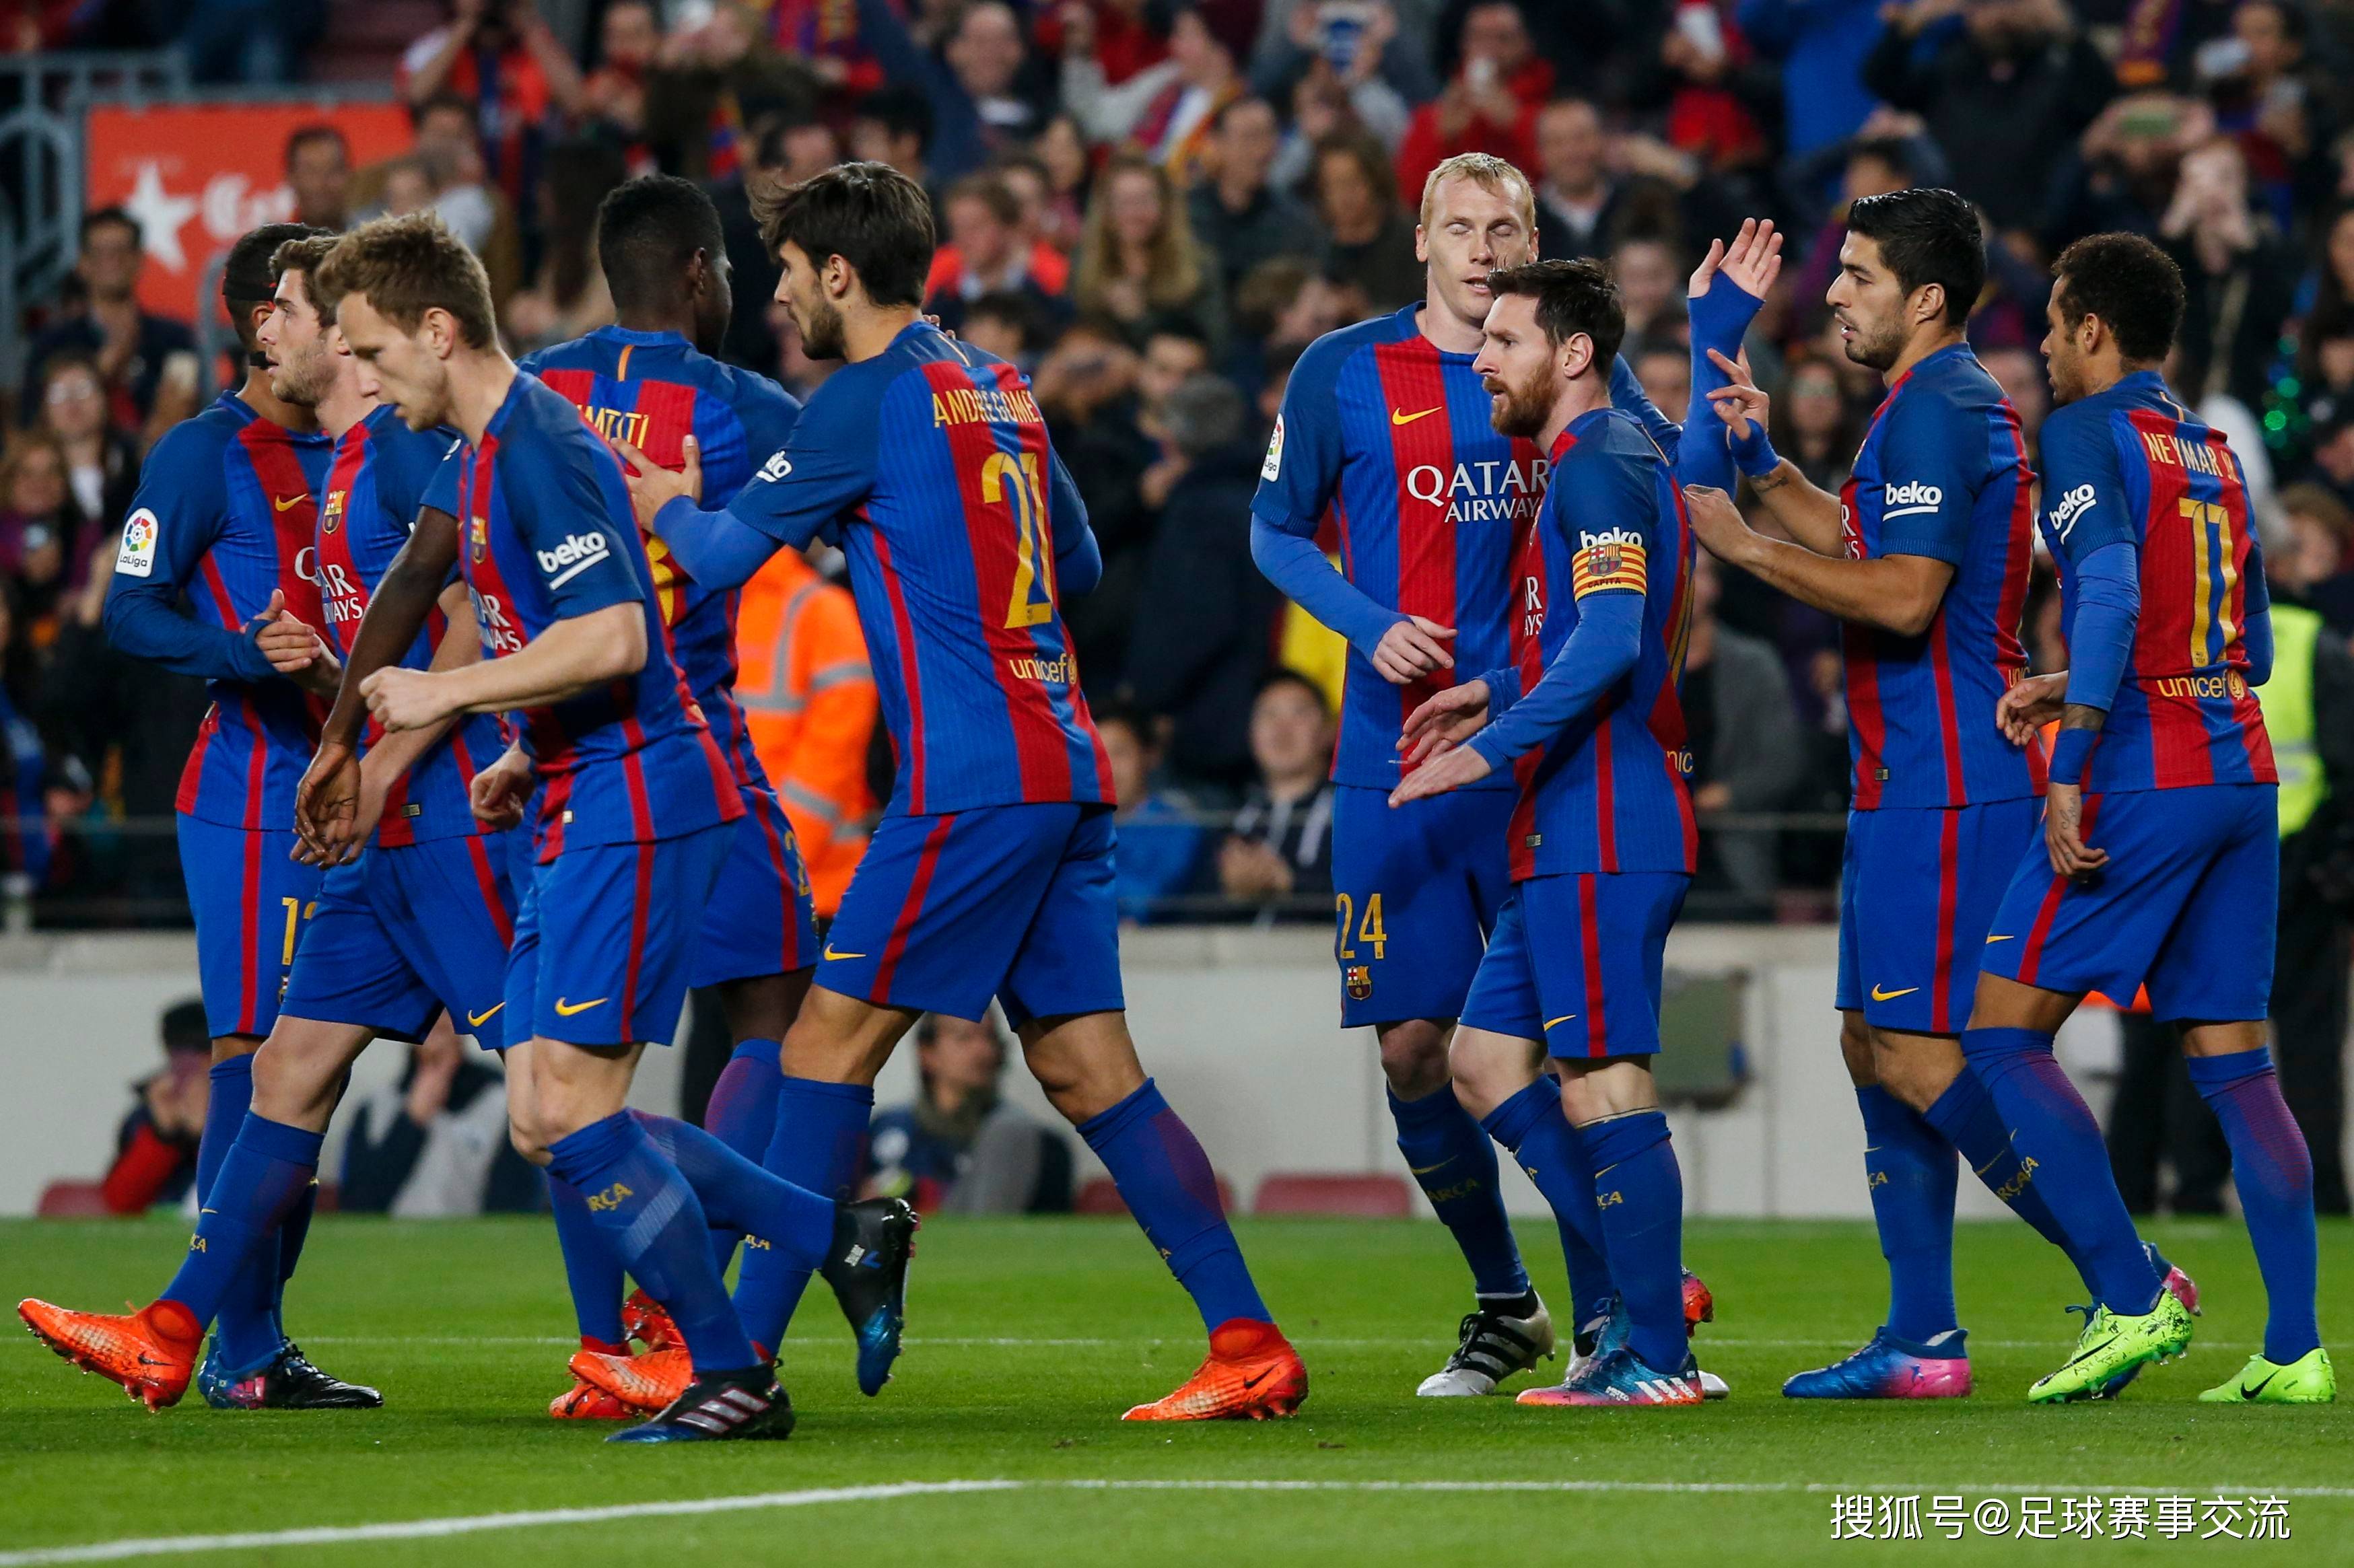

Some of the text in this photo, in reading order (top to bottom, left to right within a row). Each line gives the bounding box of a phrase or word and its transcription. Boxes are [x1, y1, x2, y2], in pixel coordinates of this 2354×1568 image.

[2142, 431, 2223, 478] NEYMAR
[1407, 459, 1550, 507] QATAR
[1885, 480, 1943, 505] beko
[1444, 497, 1541, 523] AIRWAY
[2048, 483, 2096, 530] beko
[119, 555, 148, 567] LaLiga
[536, 532, 607, 573] beko
[981, 452, 1053, 630] 21
[2178, 497, 2238, 668] 11
[1009, 652, 1067, 684] unicef
[2156, 669, 2227, 699] unicef
[1666, 746, 1694, 773] nic
[281, 896, 317, 965] 1
[1336, 892, 1387, 960] 24
[586, 1182, 633, 1211] RÇA
